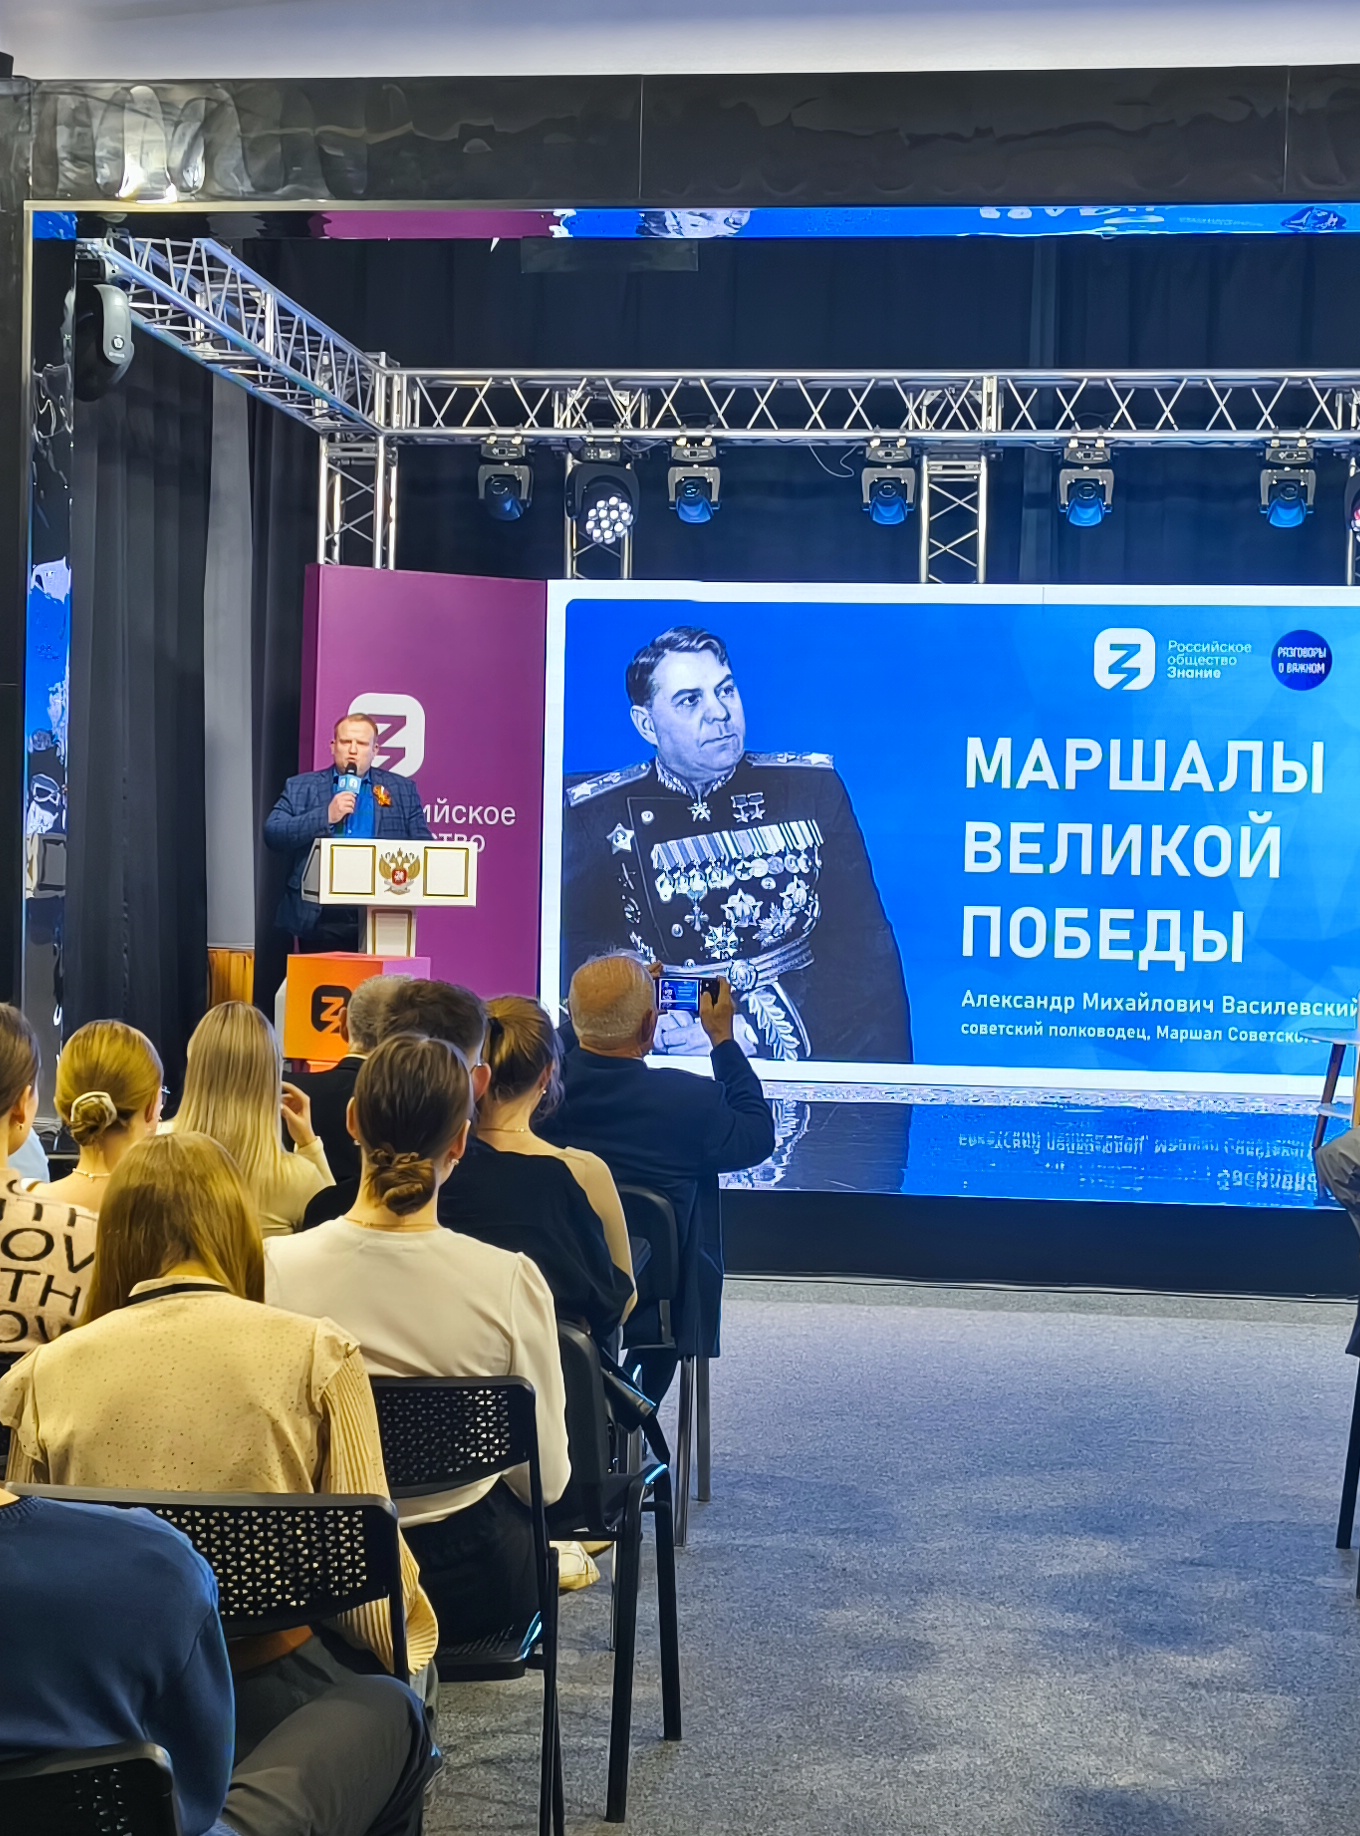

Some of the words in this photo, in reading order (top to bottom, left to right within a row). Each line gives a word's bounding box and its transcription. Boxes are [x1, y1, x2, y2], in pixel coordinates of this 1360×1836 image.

[1167, 654, 1238, 668] общество
[1168, 640, 1252, 654] Российское
[1167, 667, 1221, 679] Знание
[966, 736, 1325, 794] МАРШАЛЫ
[423, 797, 517, 826] ийское
[964, 810, 1281, 879] ВЕЛИКОЙ
[962, 905, 1245, 972] ПОБЕДЫ
[961, 989, 1075, 1015] Александр
[1082, 991, 1215, 1015] Михайлович
[1222, 995, 1358, 1018] Василевский
[961, 1020, 1043, 1037] советский
[1048, 1025, 1151, 1042] полководец,
[1156, 1026, 1223, 1043] Маршал
[1228, 1027, 1320, 1045] Советско
[0, 1267, 82, 1317] TH
